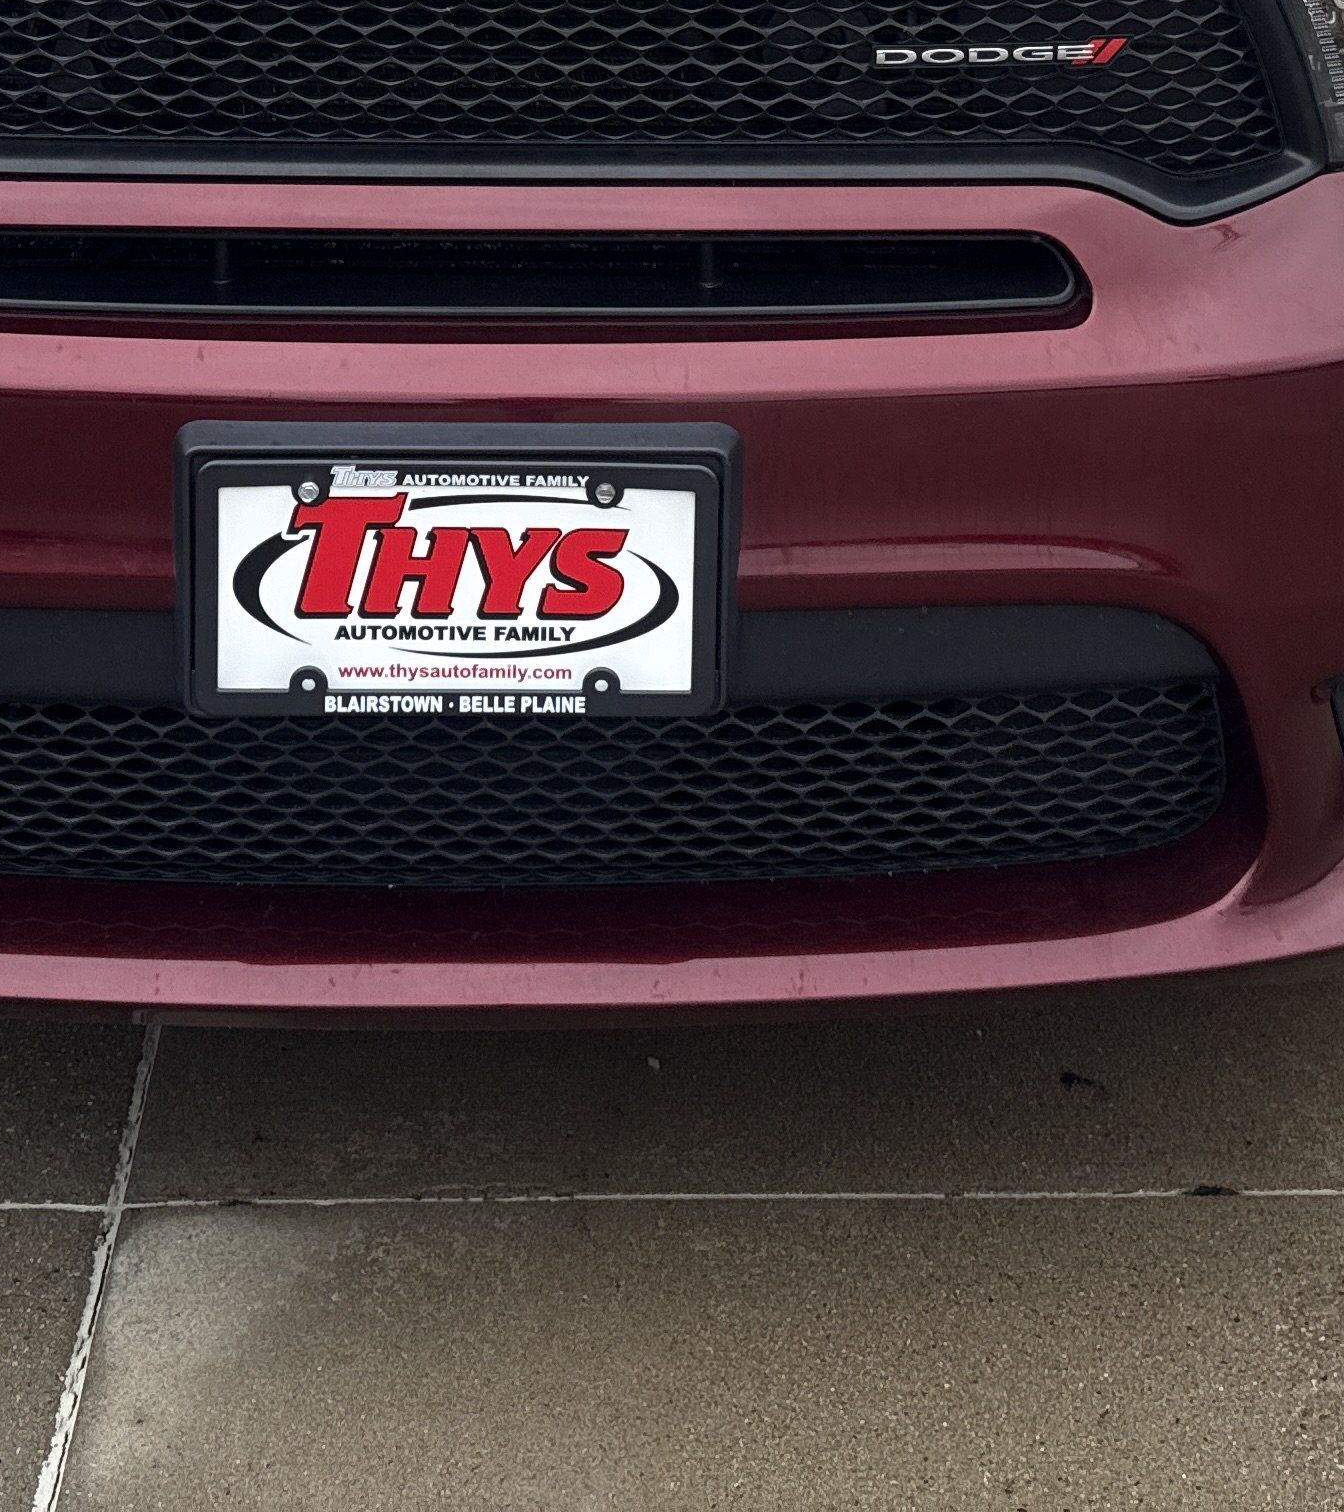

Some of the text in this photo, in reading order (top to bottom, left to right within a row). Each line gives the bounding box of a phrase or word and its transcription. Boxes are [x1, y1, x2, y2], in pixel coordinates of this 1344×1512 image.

[875, 43, 1095, 64] DODGE
[330, 465, 590, 488] THYS AUTOMOTIVE FAMILY
[289, 491, 630, 620] THYS
[334, 625, 576, 642] AUTOMOTIVE FAMILY
[337, 663, 573, 683] www.thysautofamily.com
[324, 695, 587, 715] BLAIRSTOWN BELLE PLAINE
